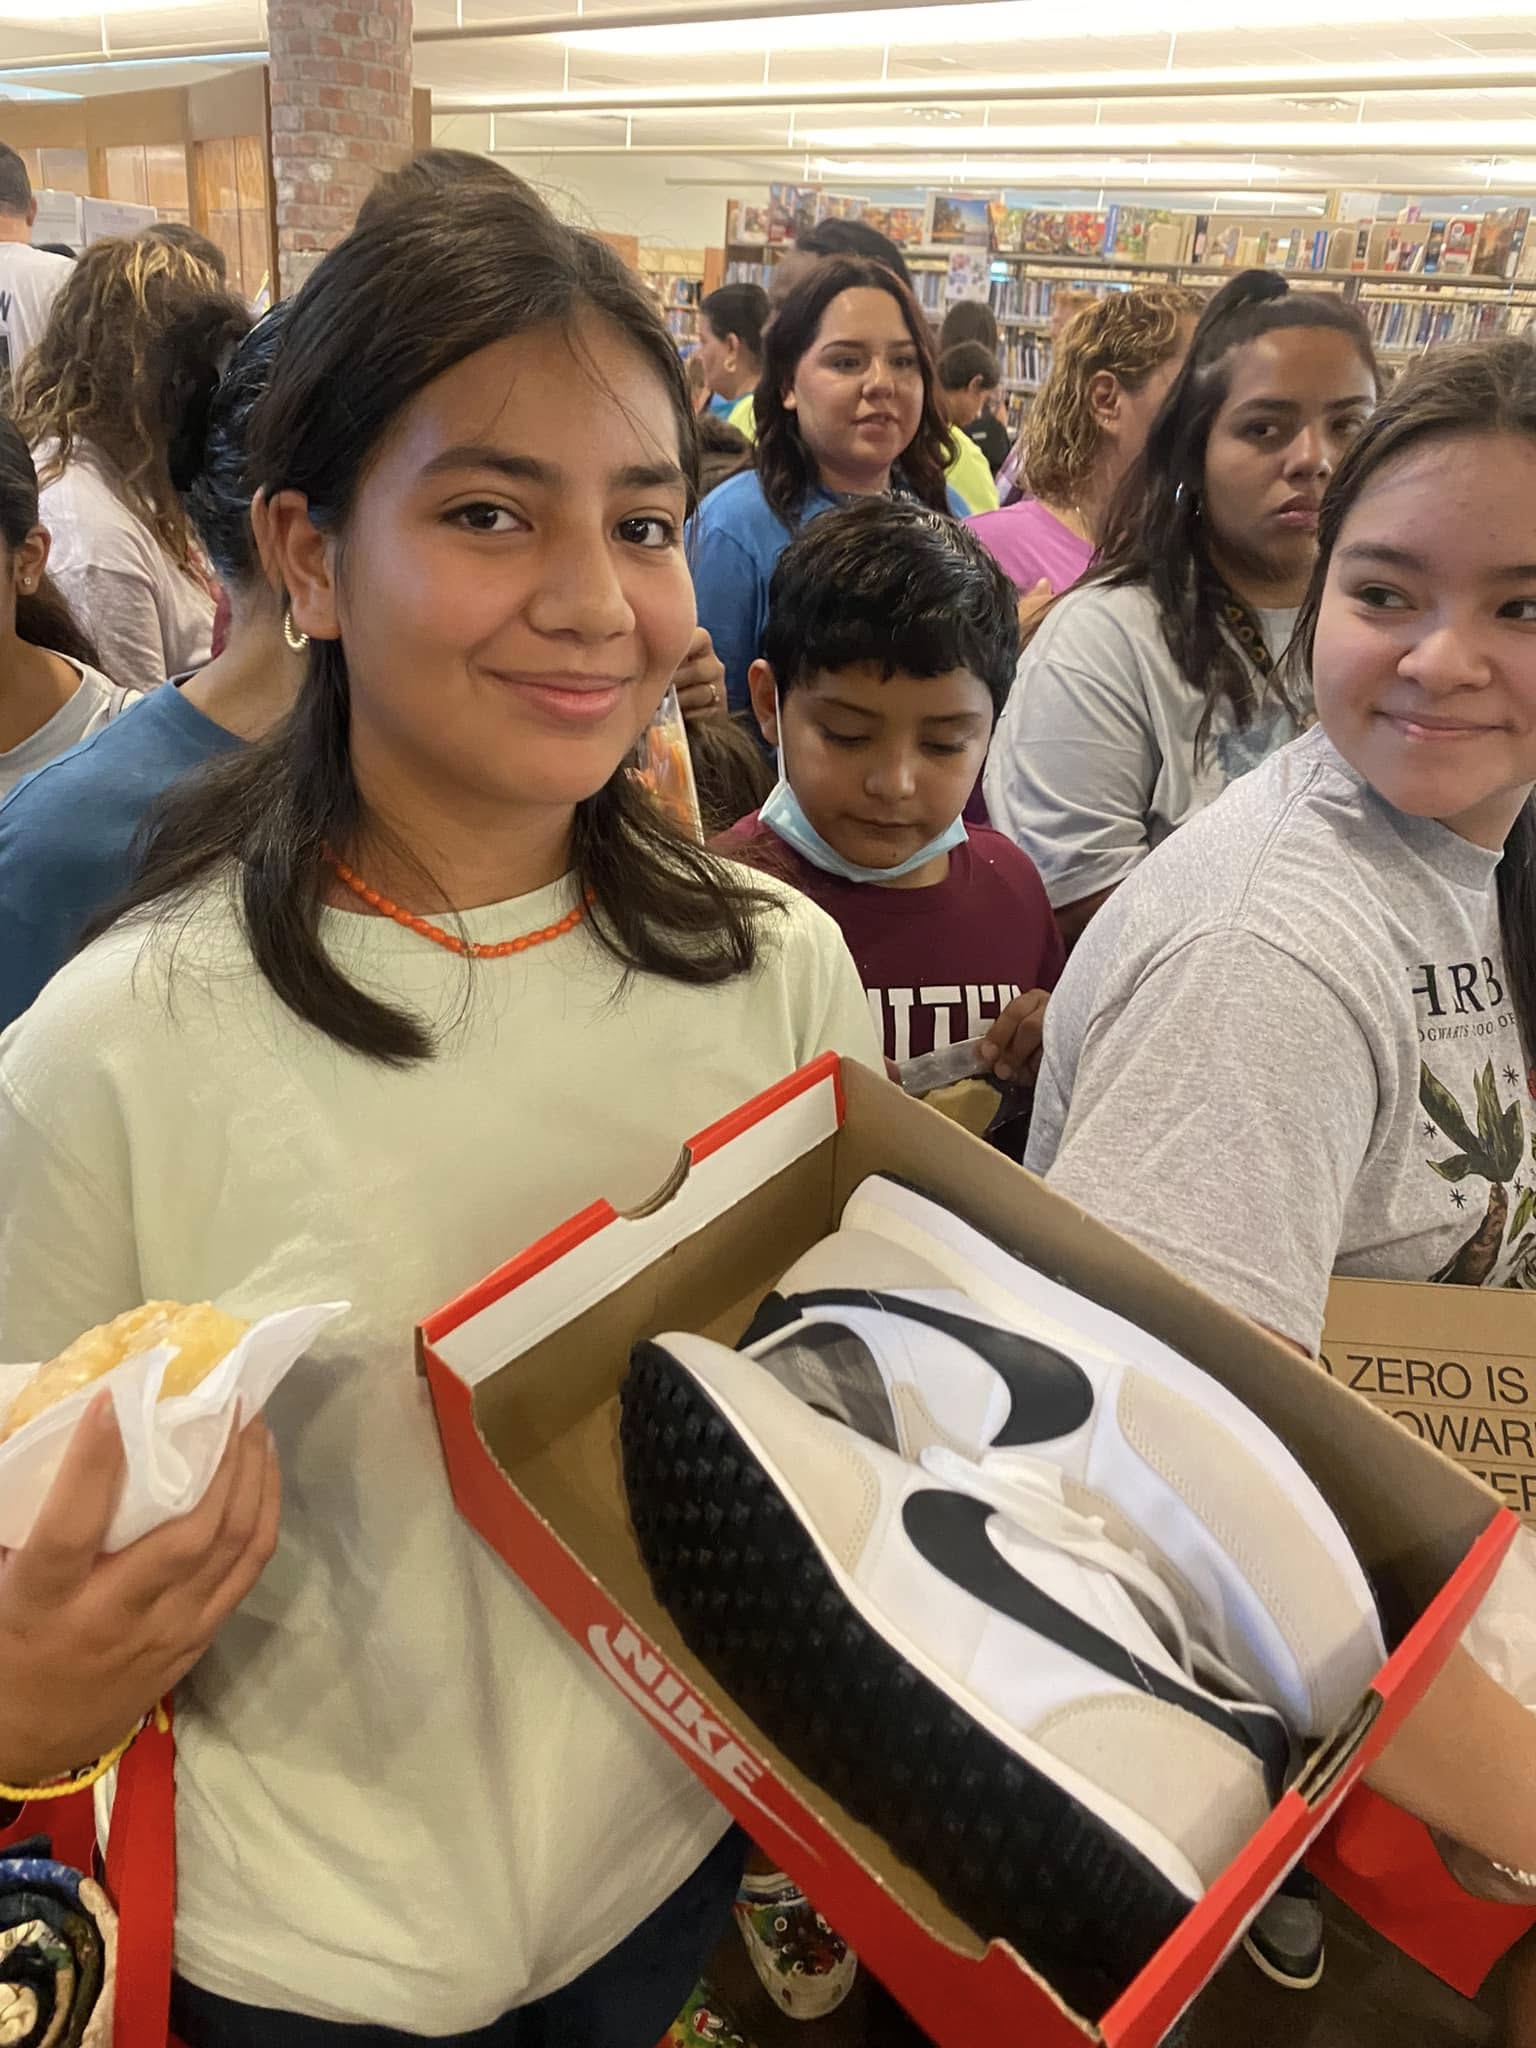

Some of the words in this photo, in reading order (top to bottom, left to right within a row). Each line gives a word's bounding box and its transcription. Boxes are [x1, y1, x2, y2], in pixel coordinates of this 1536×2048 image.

[1346, 1354, 1472, 1400] ZERO
[1486, 1365, 1529, 1405] IS
[612, 1625, 764, 1788] NIKE
